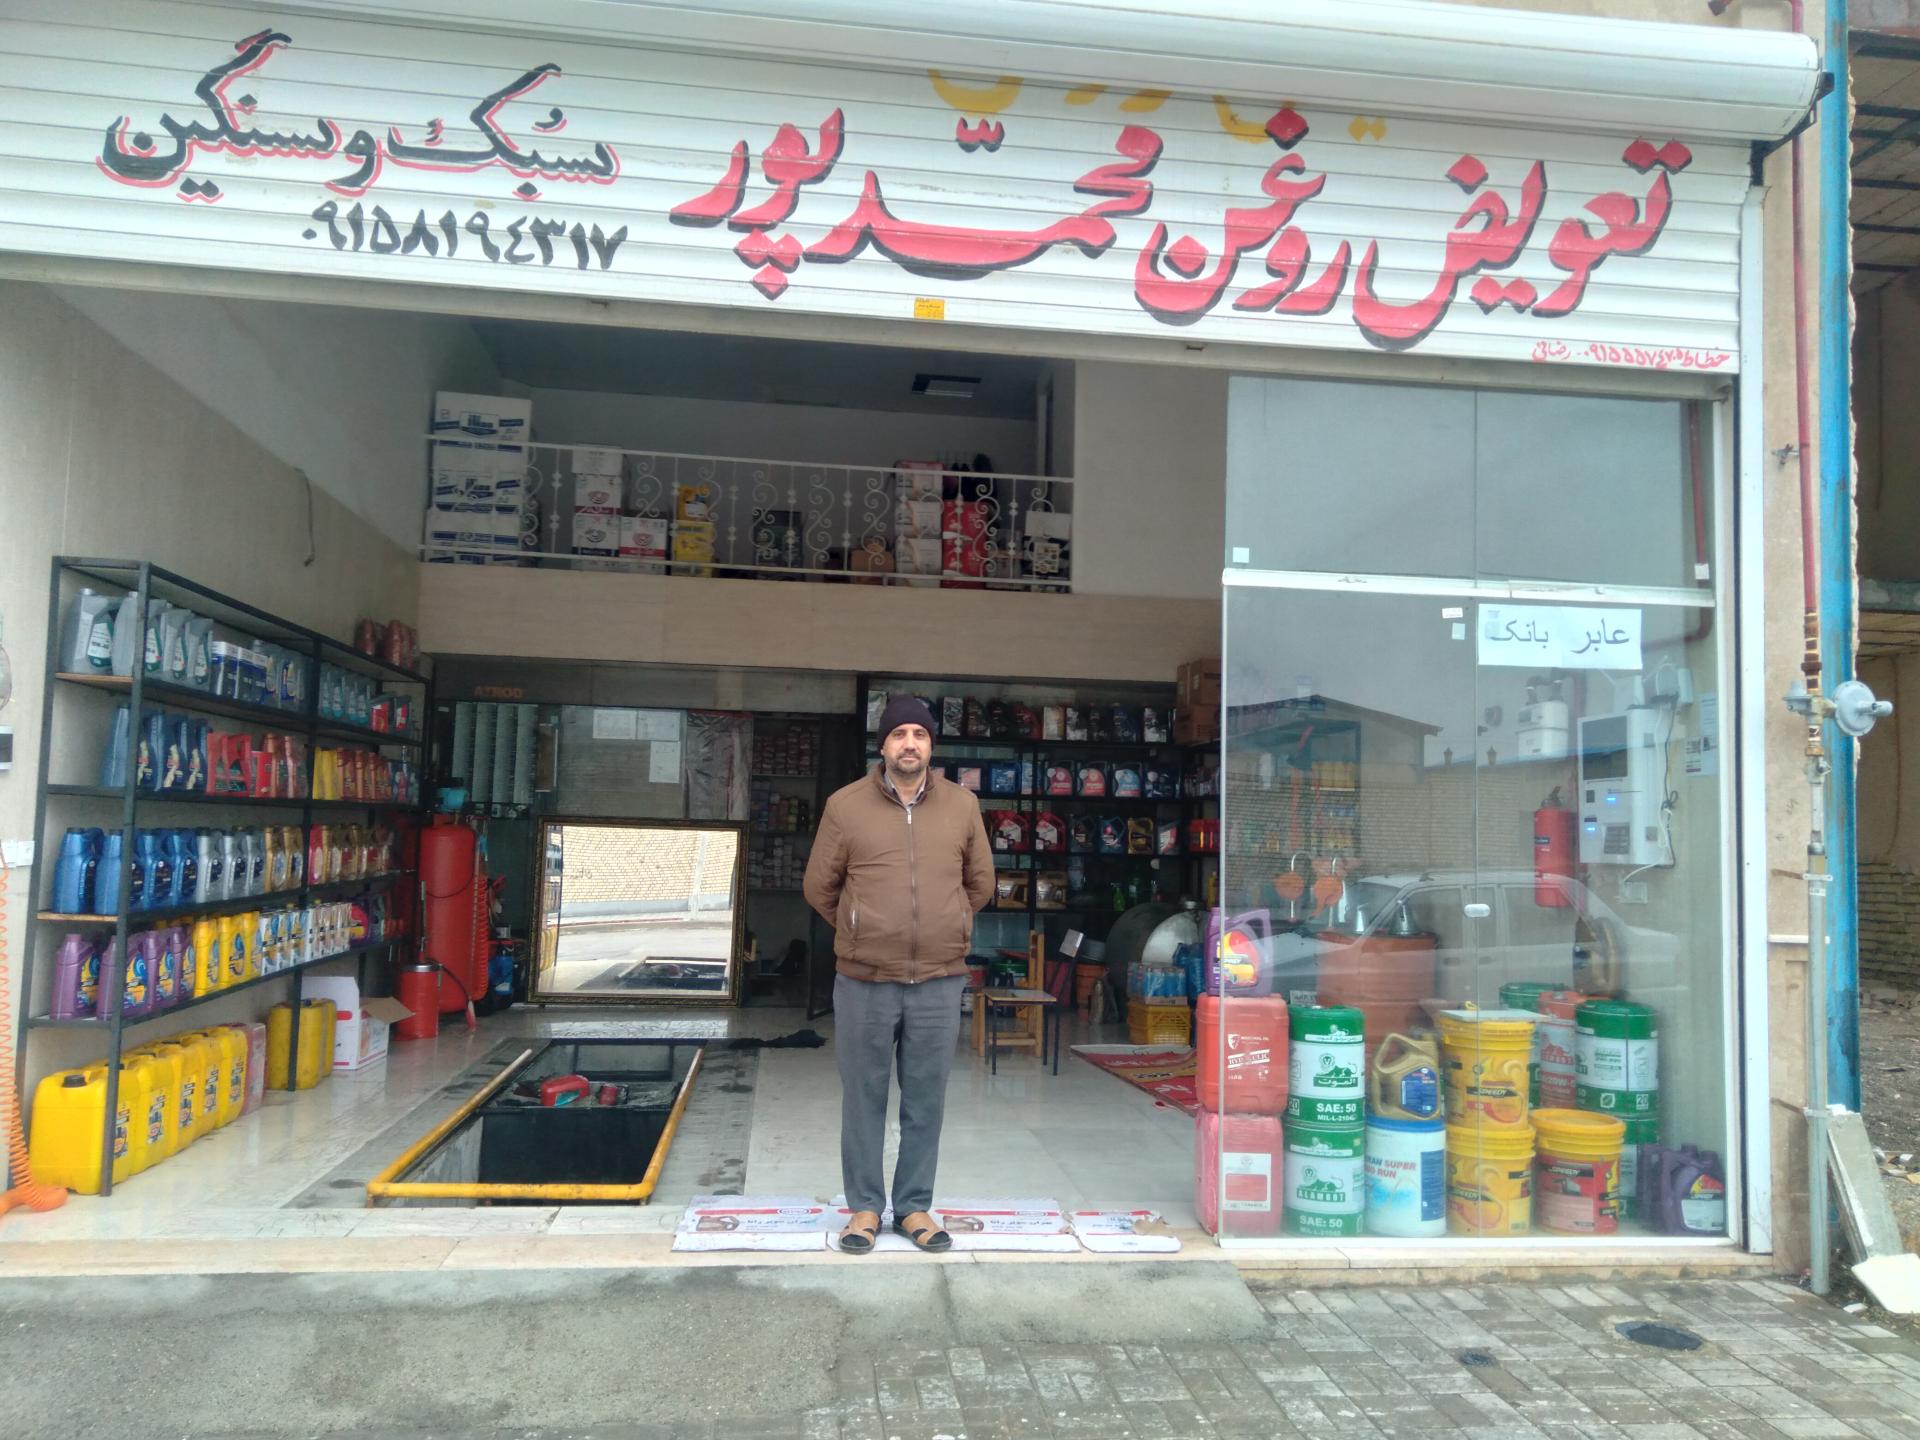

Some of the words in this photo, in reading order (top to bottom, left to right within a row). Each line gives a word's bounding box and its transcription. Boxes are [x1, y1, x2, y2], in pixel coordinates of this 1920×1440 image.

[1133, 106, 1352, 327] روغن
[1352, 135, 1693, 352] تعویض
[1489, 619, 1550, 650] بانک
[1570, 618, 1631, 654] عابر
[1316, 1102, 1344, 1114] SAE:
[1345, 1102, 1357, 1114] 50
[1383, 1159, 1417, 1171] SUPER
[1377, 1168, 1397, 1179] RUN
[1297, 1189, 1345, 1201] ALAMOOT
[1299, 1215, 1327, 1227] SAE:
[1328, 1218, 1343, 1229] 50
